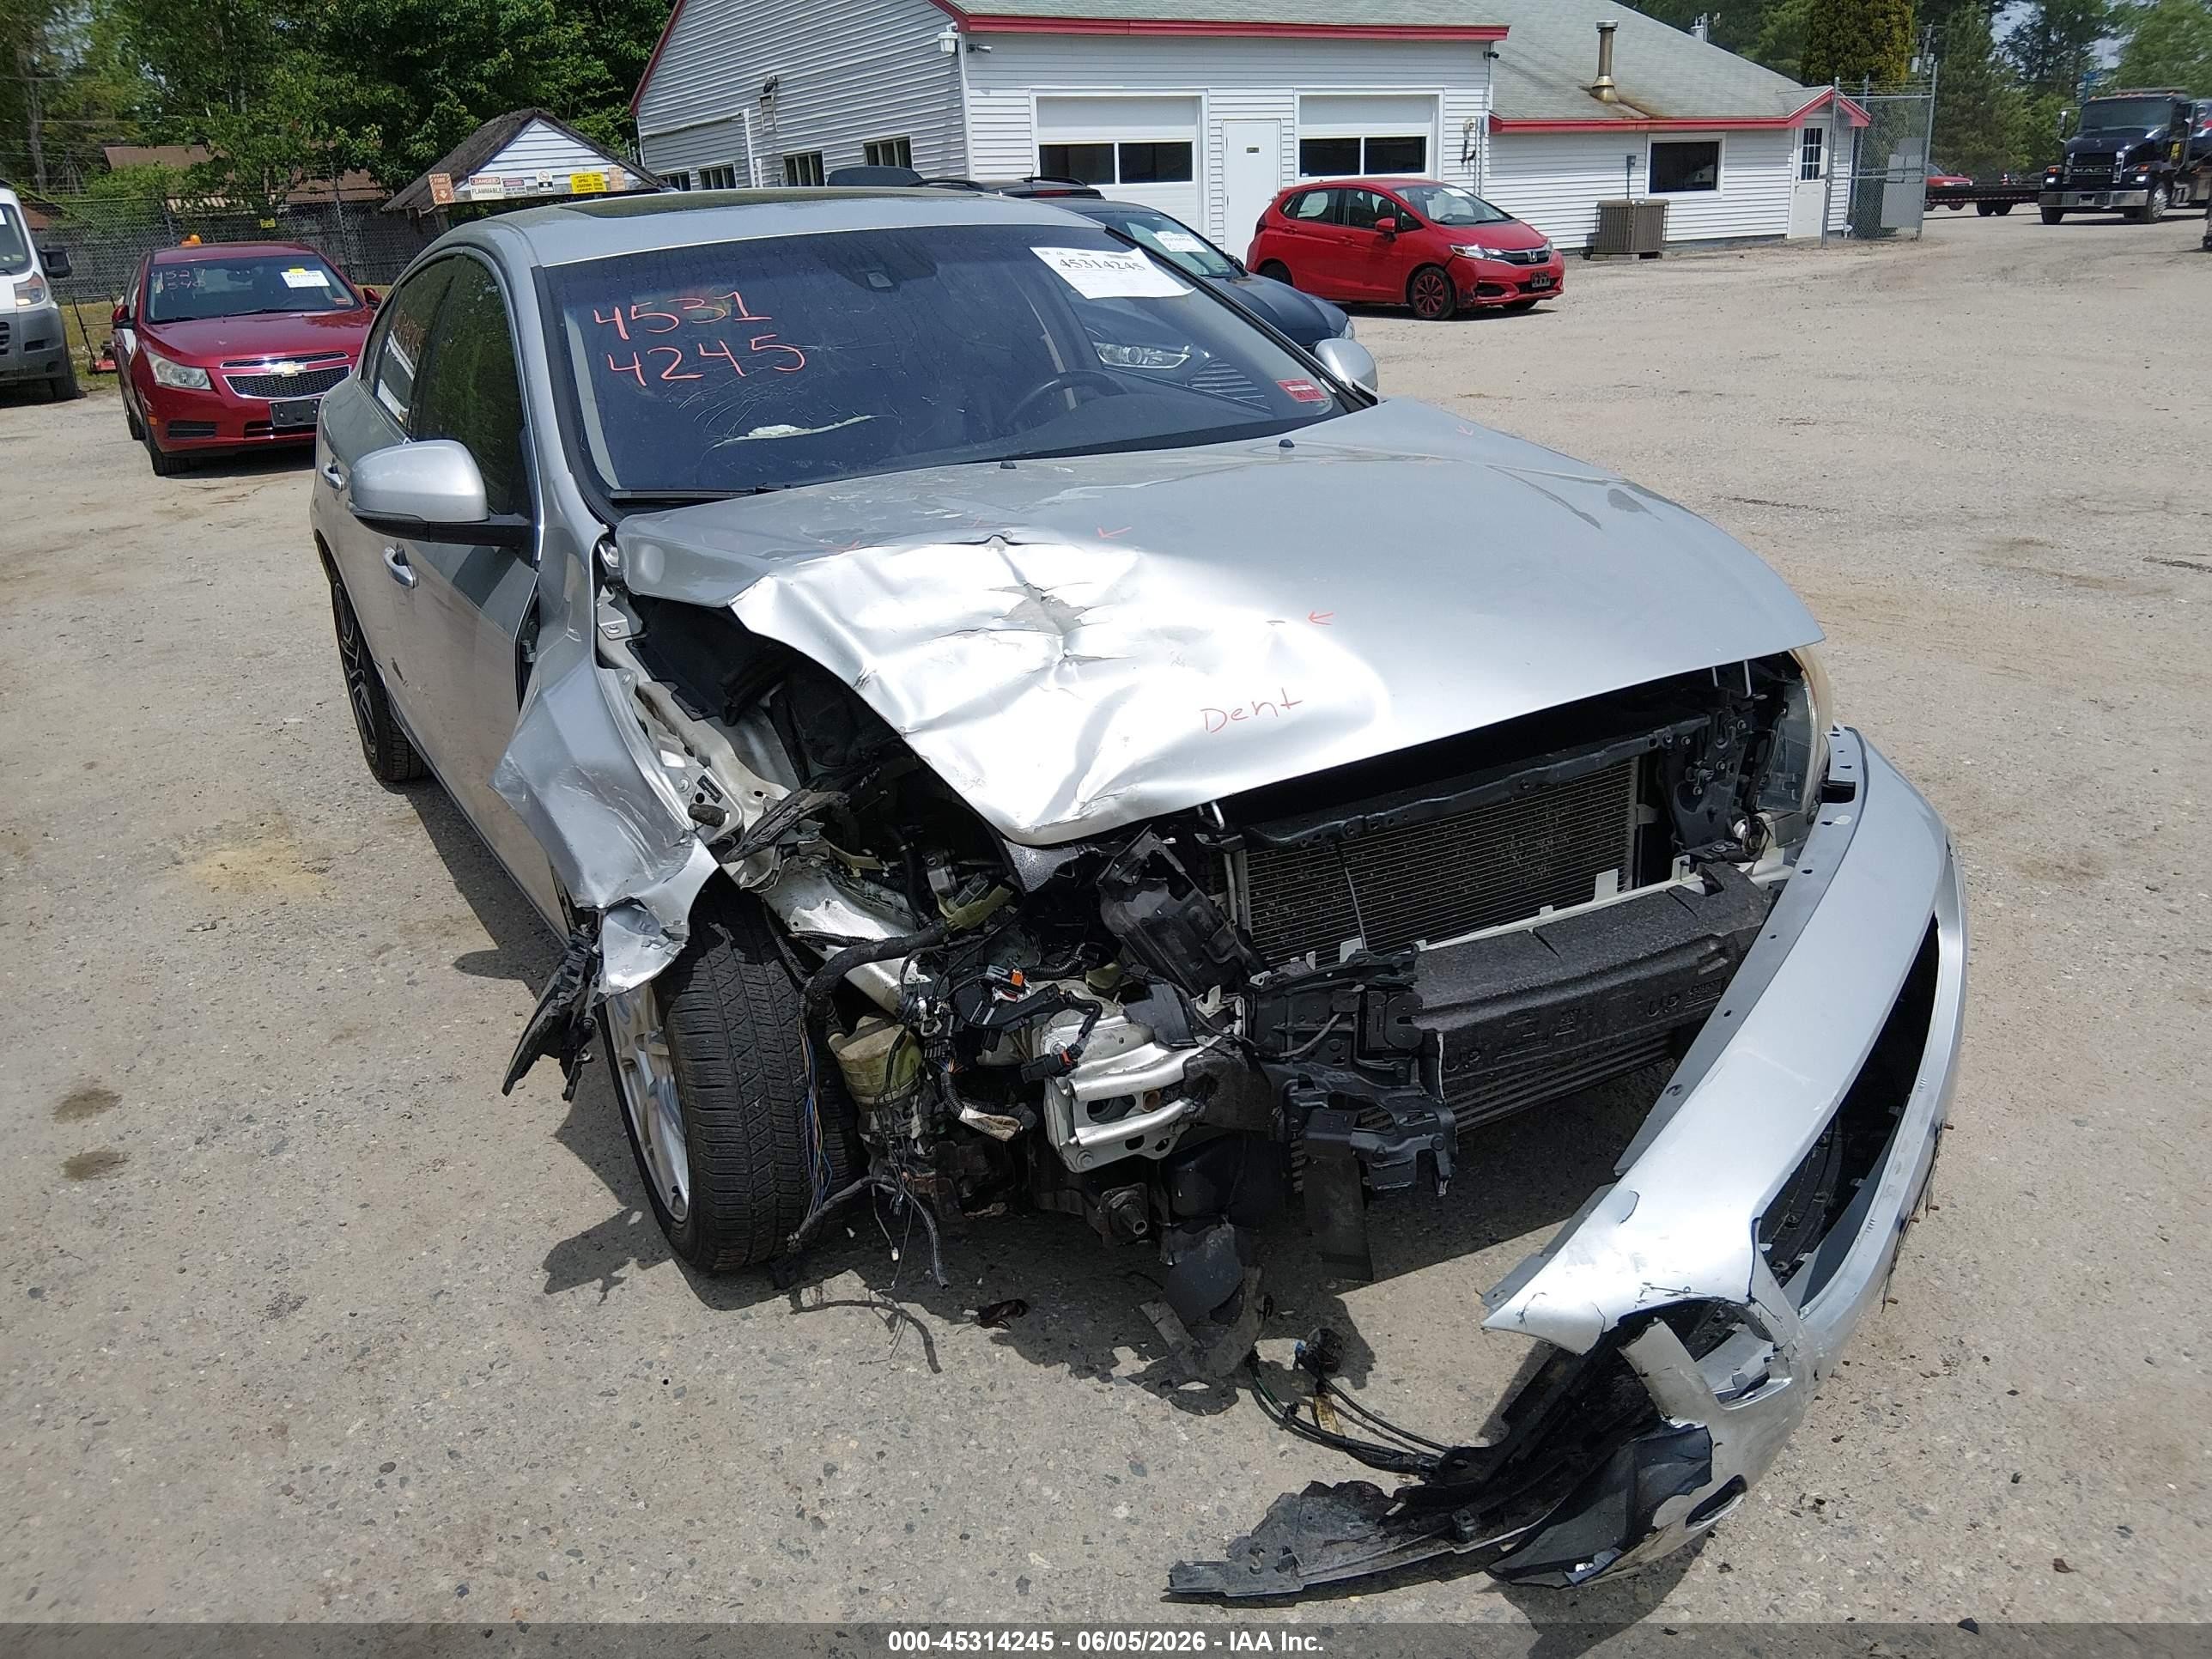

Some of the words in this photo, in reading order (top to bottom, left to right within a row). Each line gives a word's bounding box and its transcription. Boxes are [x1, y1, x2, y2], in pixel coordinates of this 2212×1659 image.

[1060, 258, 1146, 271] 45314245
[593, 290, 772, 340] 4531
[607, 334, 805, 386] 4245
[1200, 687, 1303, 733] Dent
